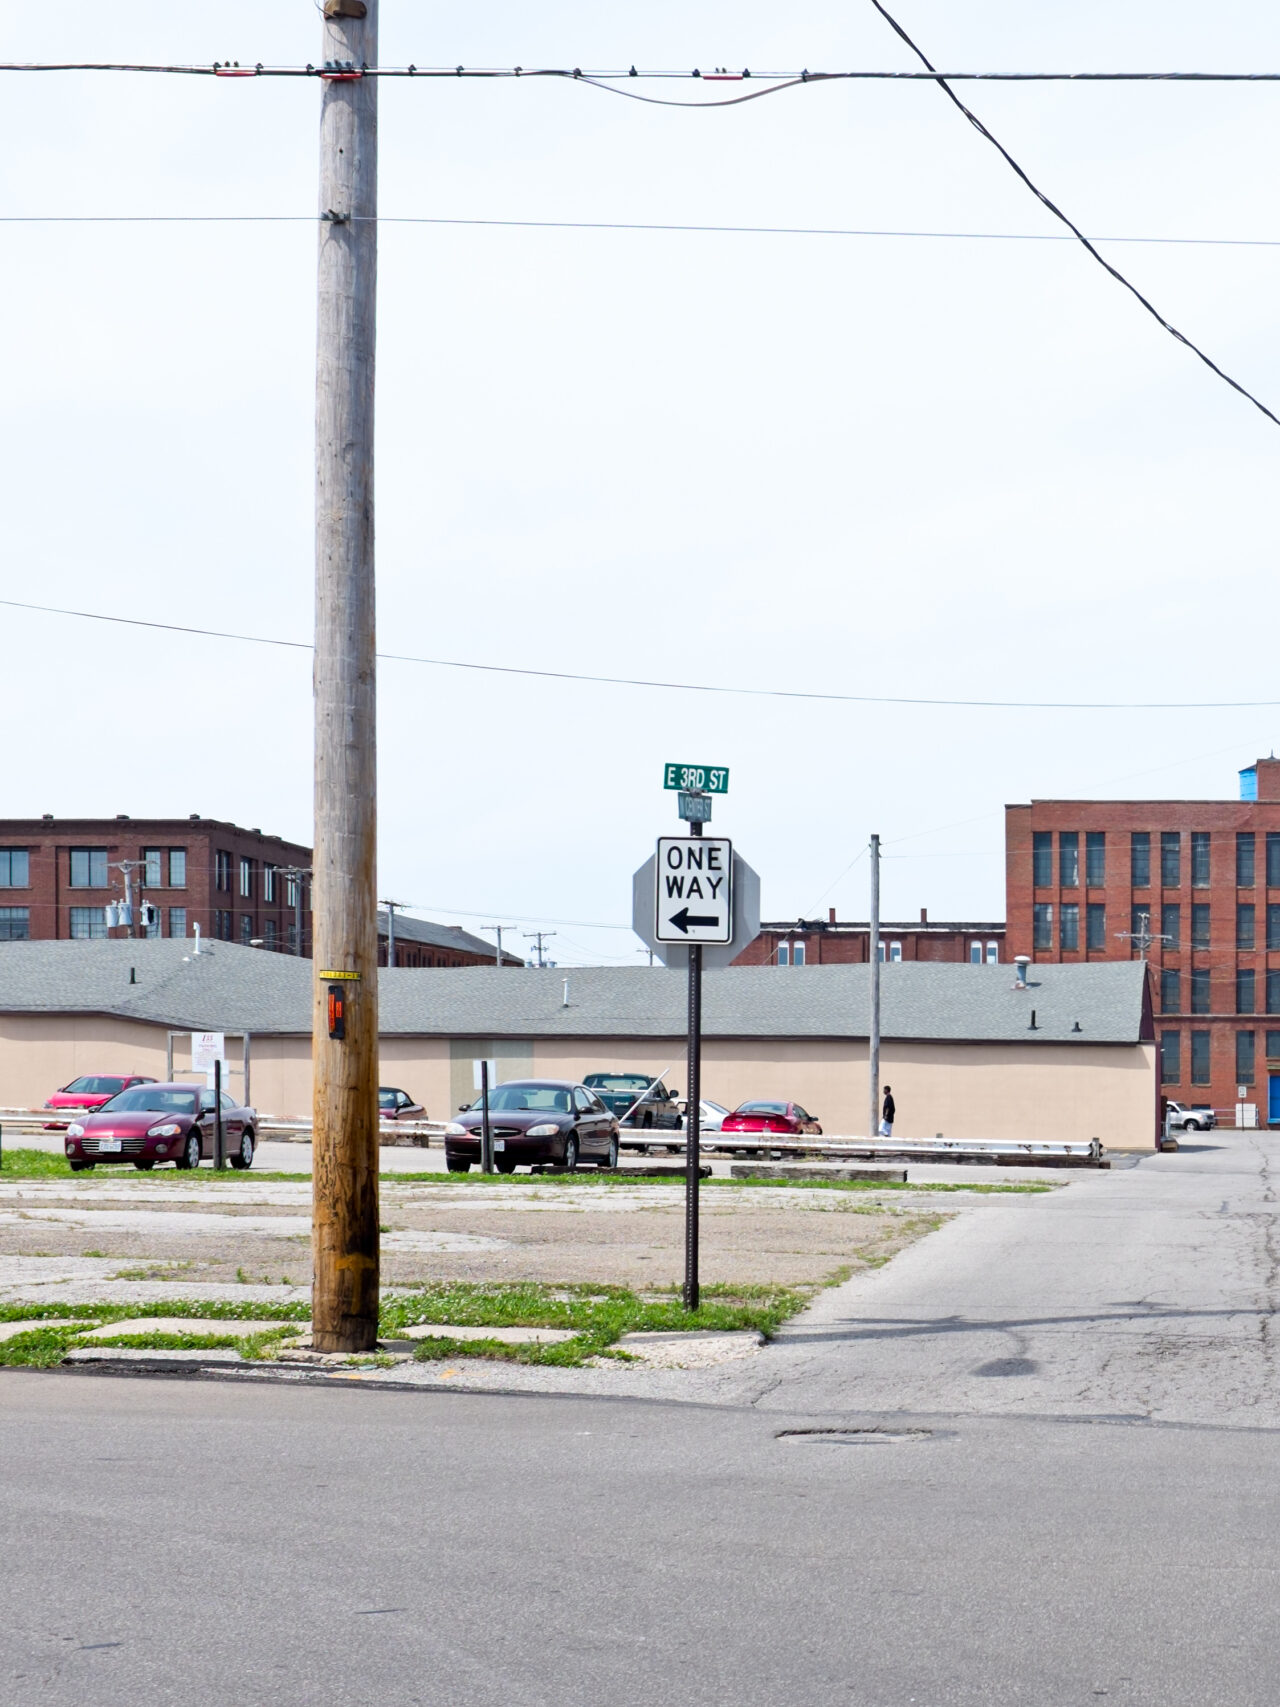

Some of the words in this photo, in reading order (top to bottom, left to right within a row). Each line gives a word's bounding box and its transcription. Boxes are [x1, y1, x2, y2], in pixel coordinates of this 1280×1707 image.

[667, 766, 676, 786] E
[680, 767, 705, 788] 3RD
[709, 769, 726, 790] ST
[667, 845, 722, 871] ONE
[666, 875, 723, 900] WAY
